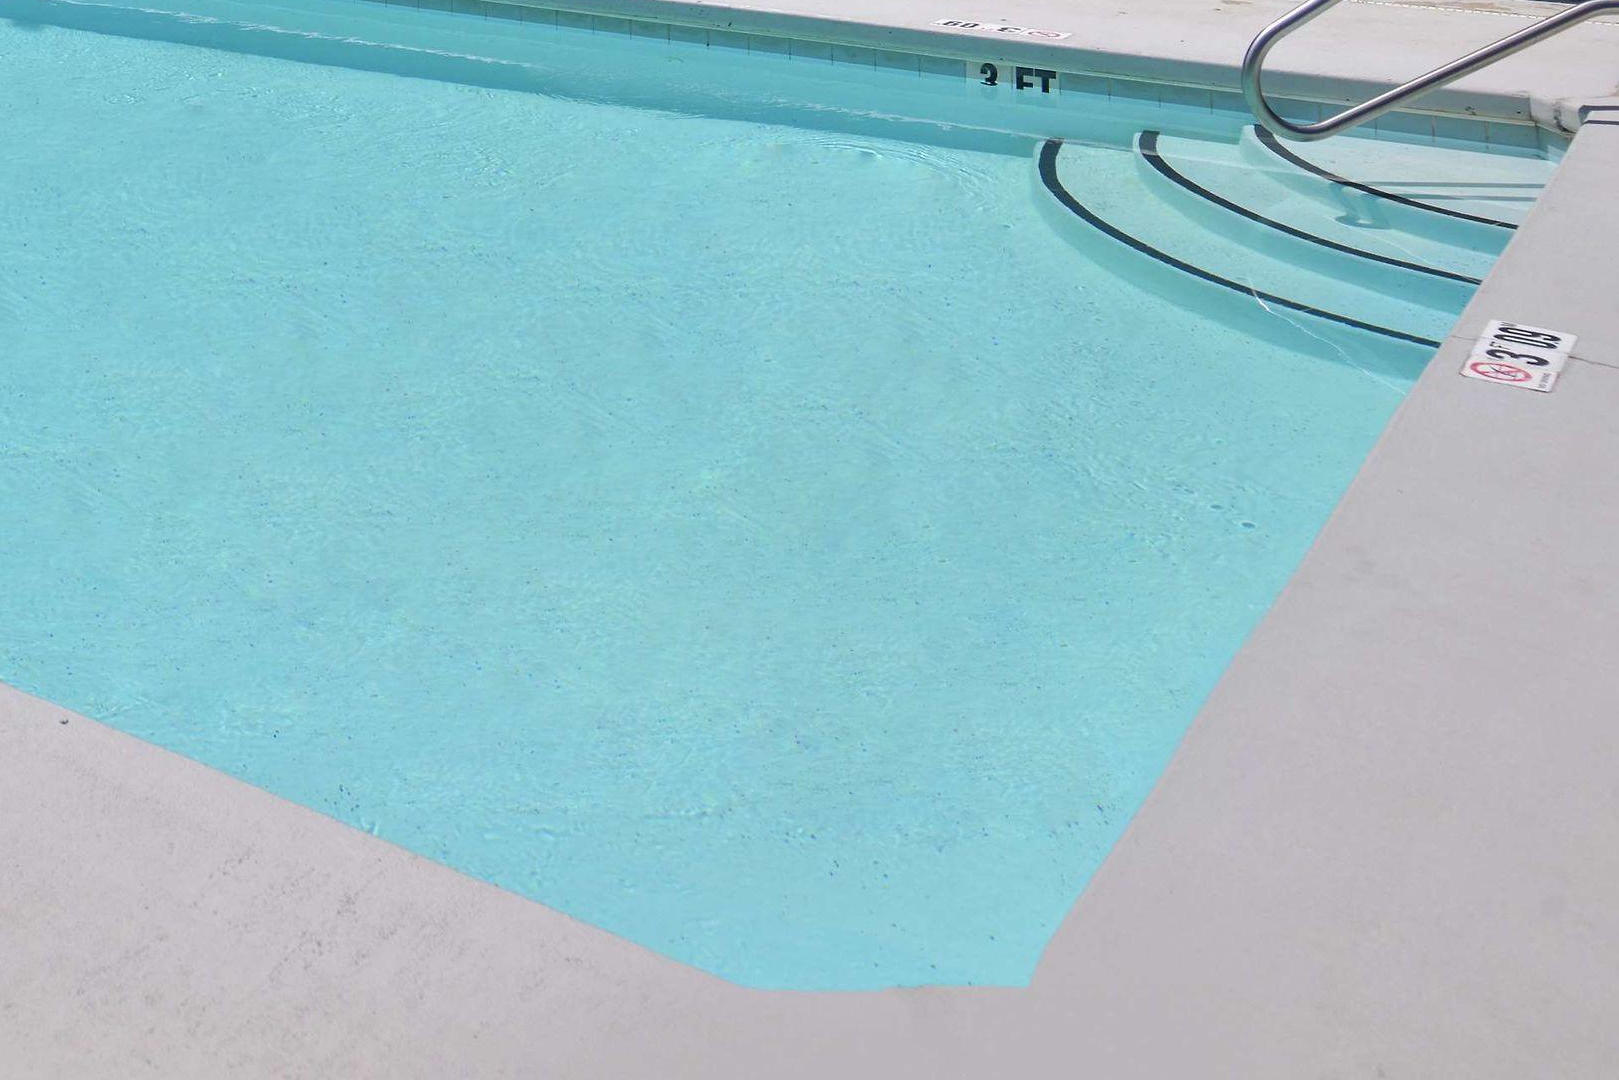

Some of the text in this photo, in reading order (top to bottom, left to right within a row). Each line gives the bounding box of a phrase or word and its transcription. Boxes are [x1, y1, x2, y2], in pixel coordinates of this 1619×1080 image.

[980, 62, 1057, 94] 3 FT
[1485, 348, 1550, 367] 3
